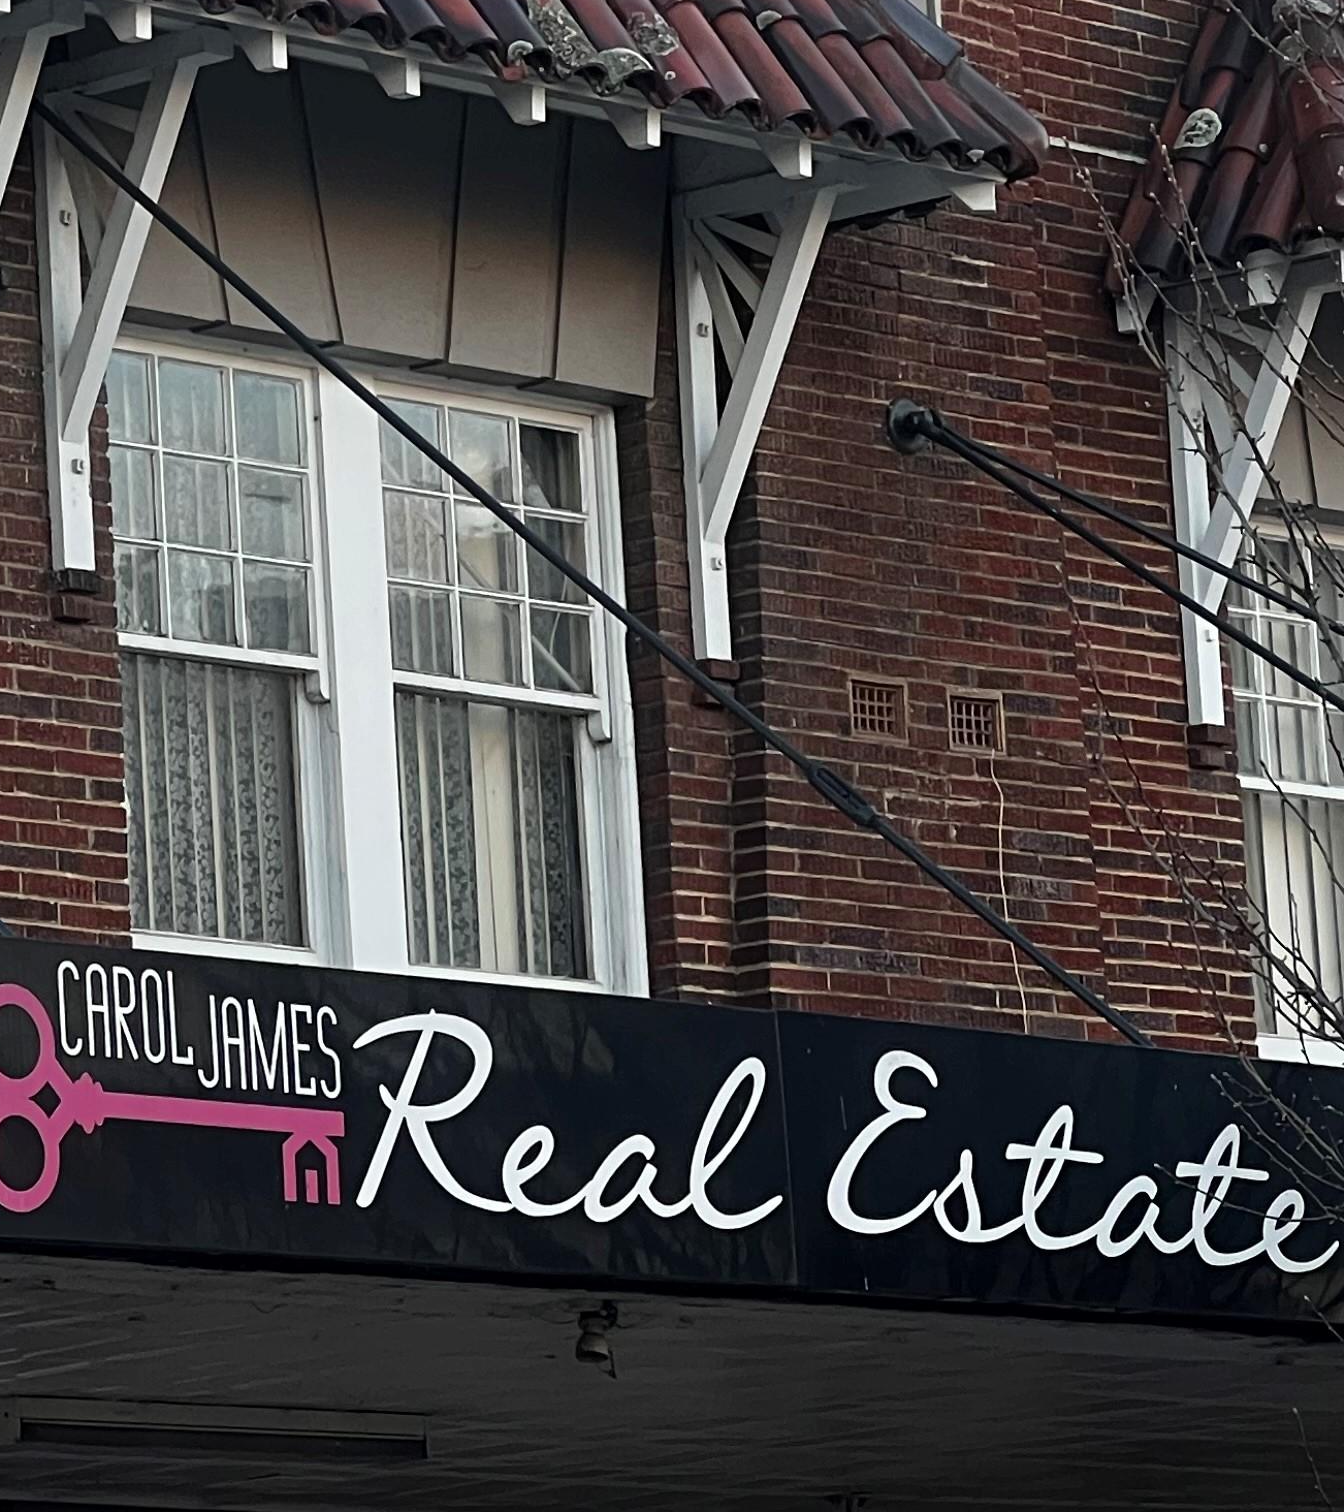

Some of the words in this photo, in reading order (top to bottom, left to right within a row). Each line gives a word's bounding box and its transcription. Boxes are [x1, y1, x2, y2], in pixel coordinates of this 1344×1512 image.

[57, 960, 195, 1066] CAROL
[197, 994, 343, 1100] JAMES
[352, 1008, 786, 1232] Real
[826, 1048, 1341, 1276] Estate
